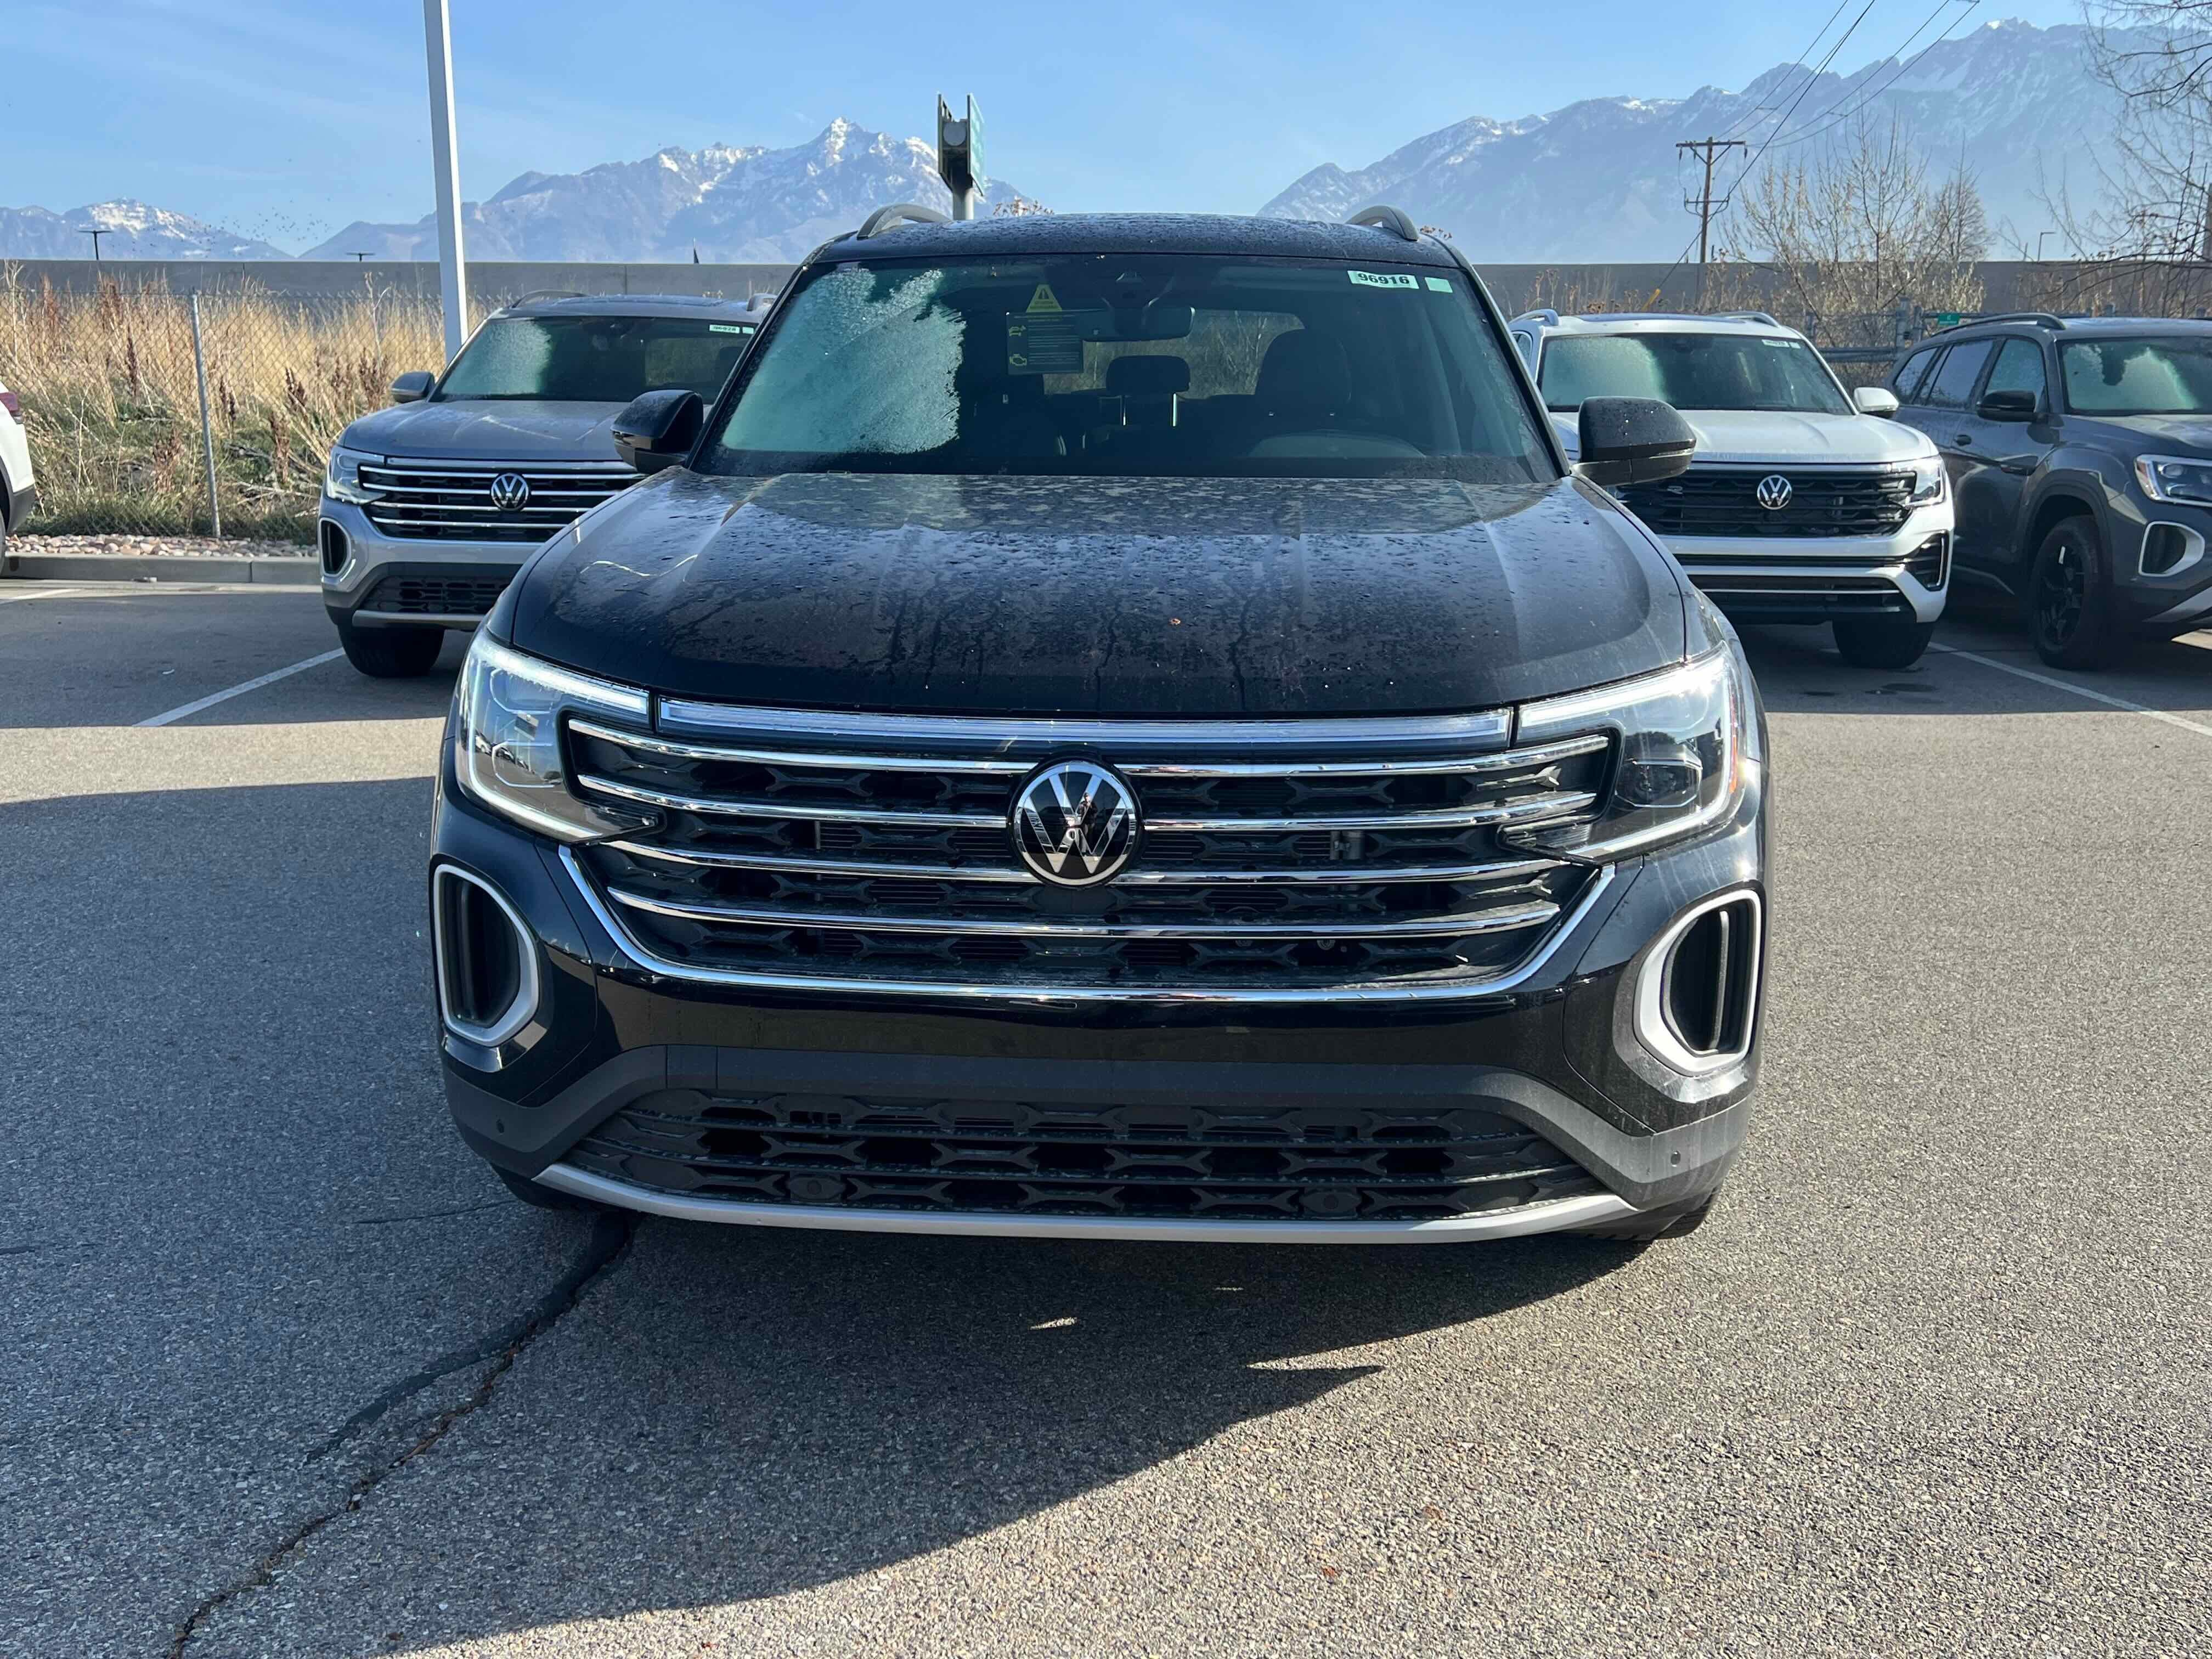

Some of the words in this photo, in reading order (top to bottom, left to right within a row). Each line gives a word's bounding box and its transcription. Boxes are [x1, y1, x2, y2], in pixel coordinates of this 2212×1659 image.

[1358, 273, 1409, 284] 96916
[491, 473, 528, 509] VW
[1757, 475, 1792, 509] VW
[1014, 761, 1136, 884] VW
